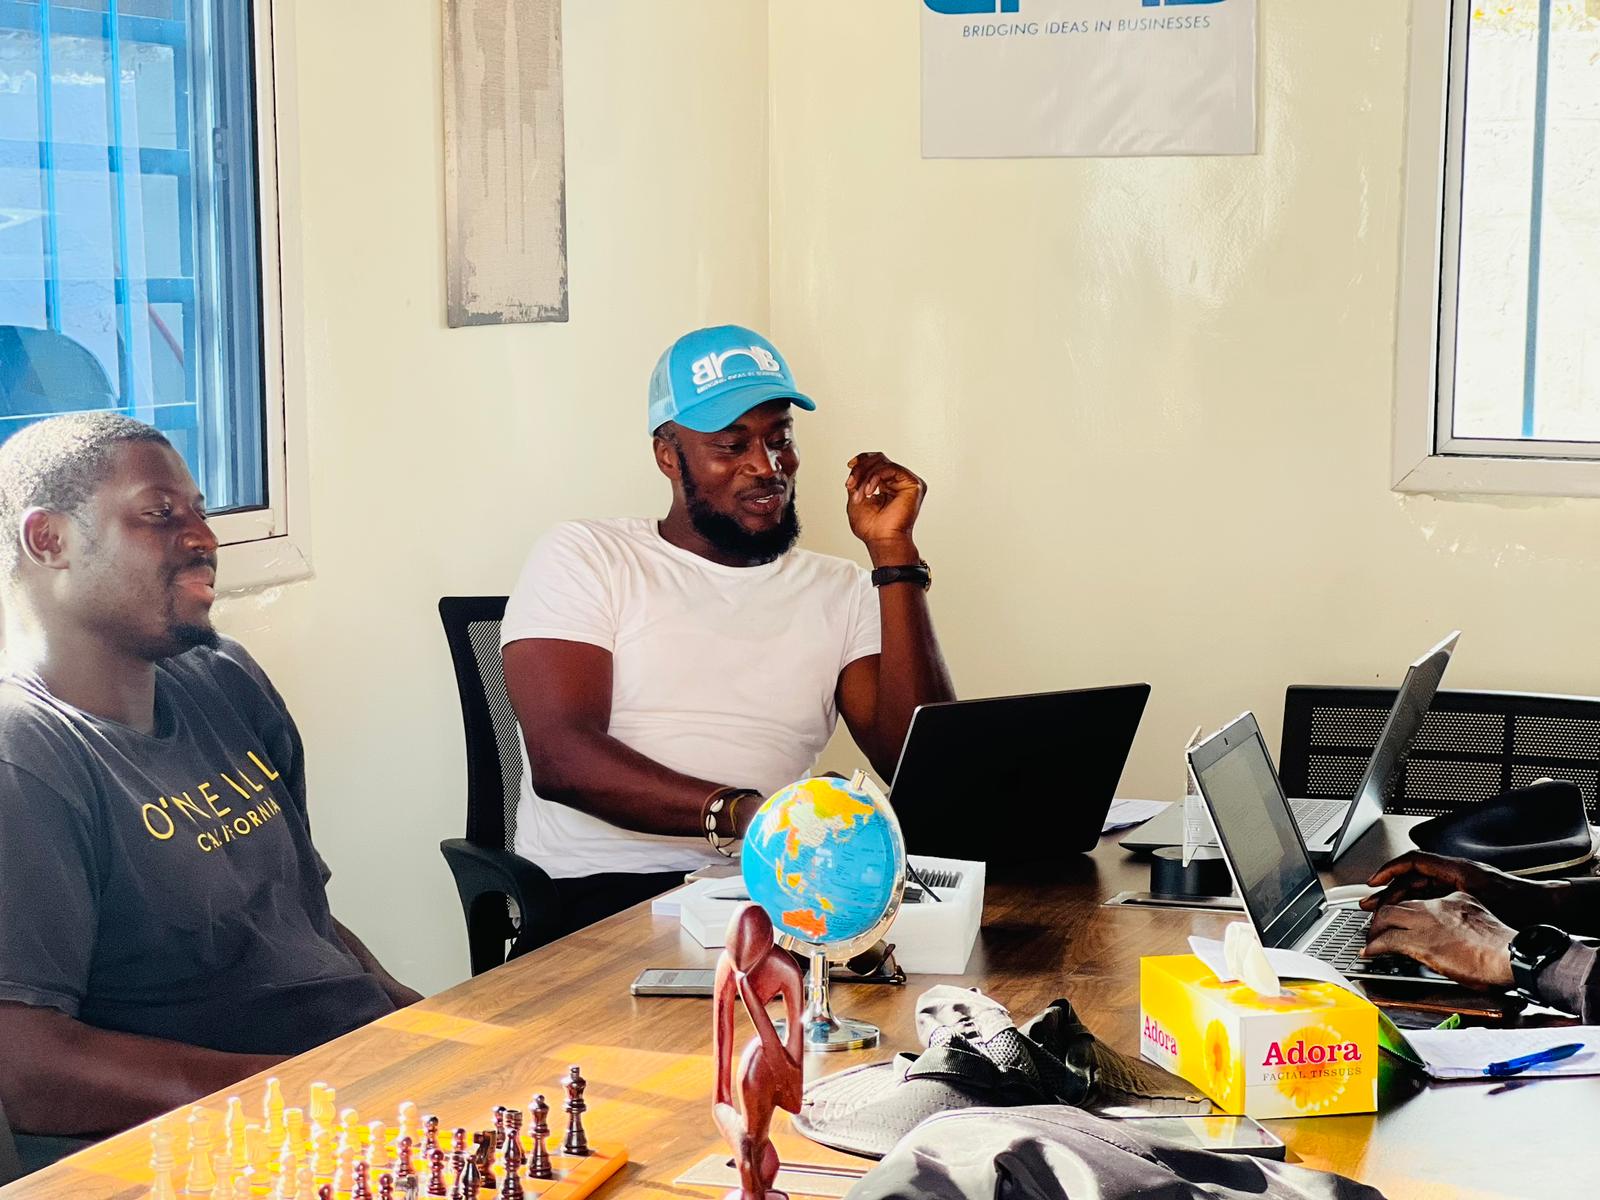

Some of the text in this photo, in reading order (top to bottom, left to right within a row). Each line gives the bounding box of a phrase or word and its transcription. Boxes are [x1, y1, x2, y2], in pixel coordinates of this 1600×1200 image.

[962, 15, 1211, 38] BRIDGING IDEAS IN BUSINESSES
[142, 750, 279, 840] O'NEILL
[1143, 1016, 1178, 1056] Adora
[1262, 1040, 1362, 1067] Adora
[1262, 1066, 1362, 1082] FACIAL TISSUES
